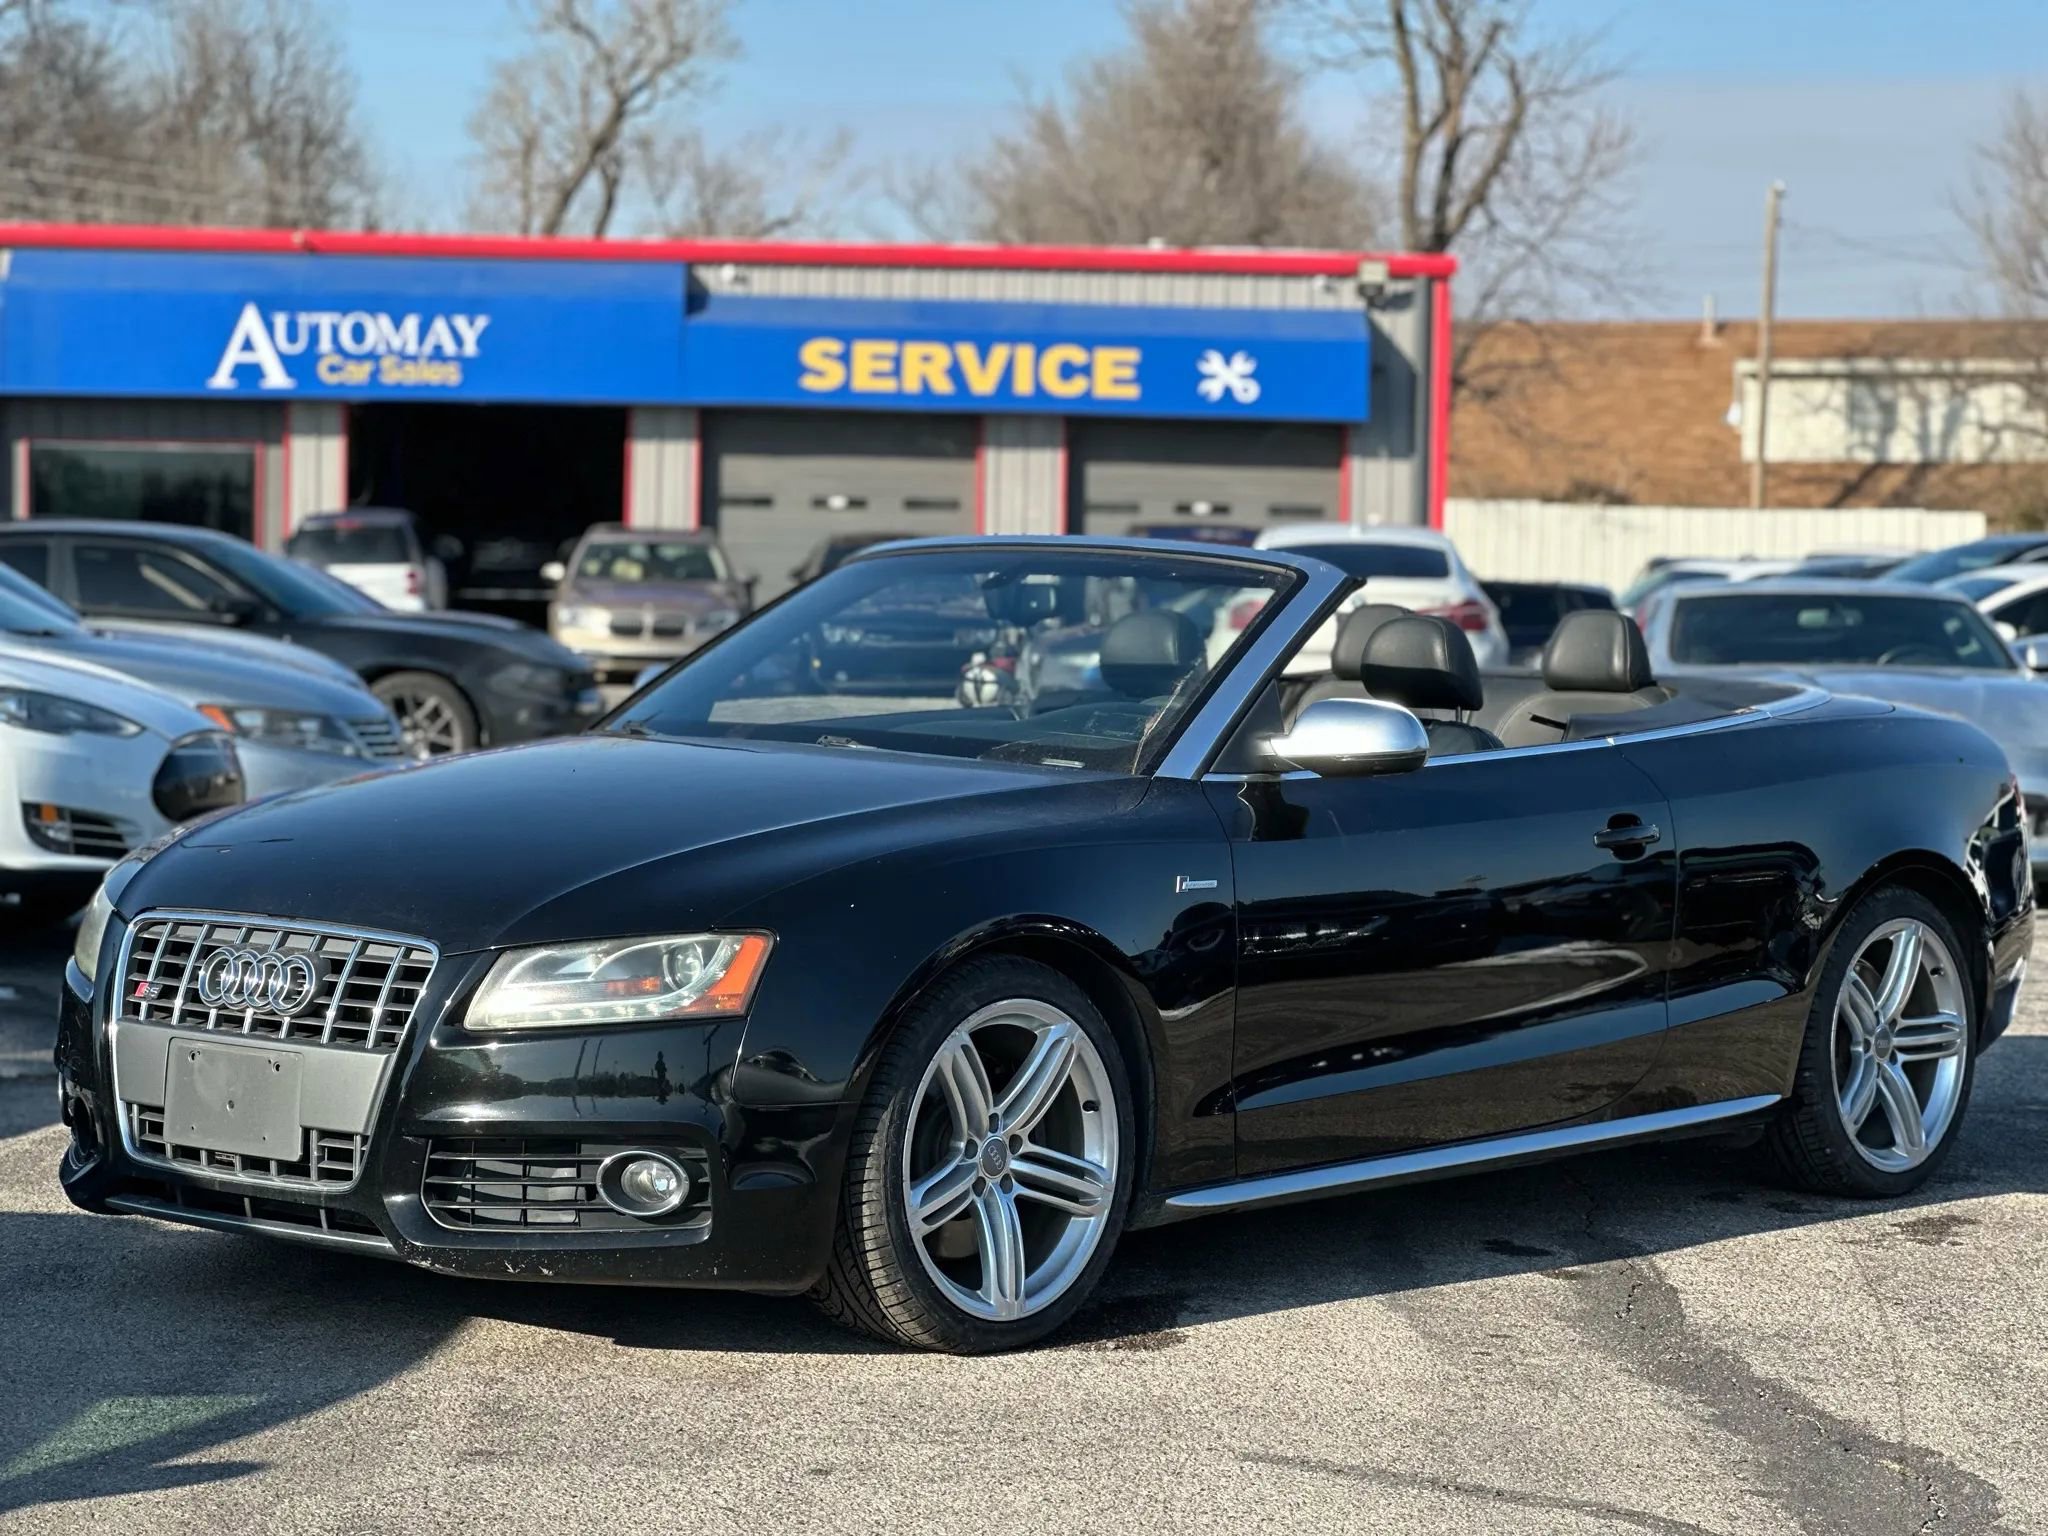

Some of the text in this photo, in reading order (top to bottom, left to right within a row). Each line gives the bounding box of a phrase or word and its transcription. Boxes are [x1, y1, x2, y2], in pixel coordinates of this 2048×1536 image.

[206, 302, 490, 389] AUTOMAY
[317, 354, 462, 387] Car Sales
[799, 337, 1141, 399] SERVICE
